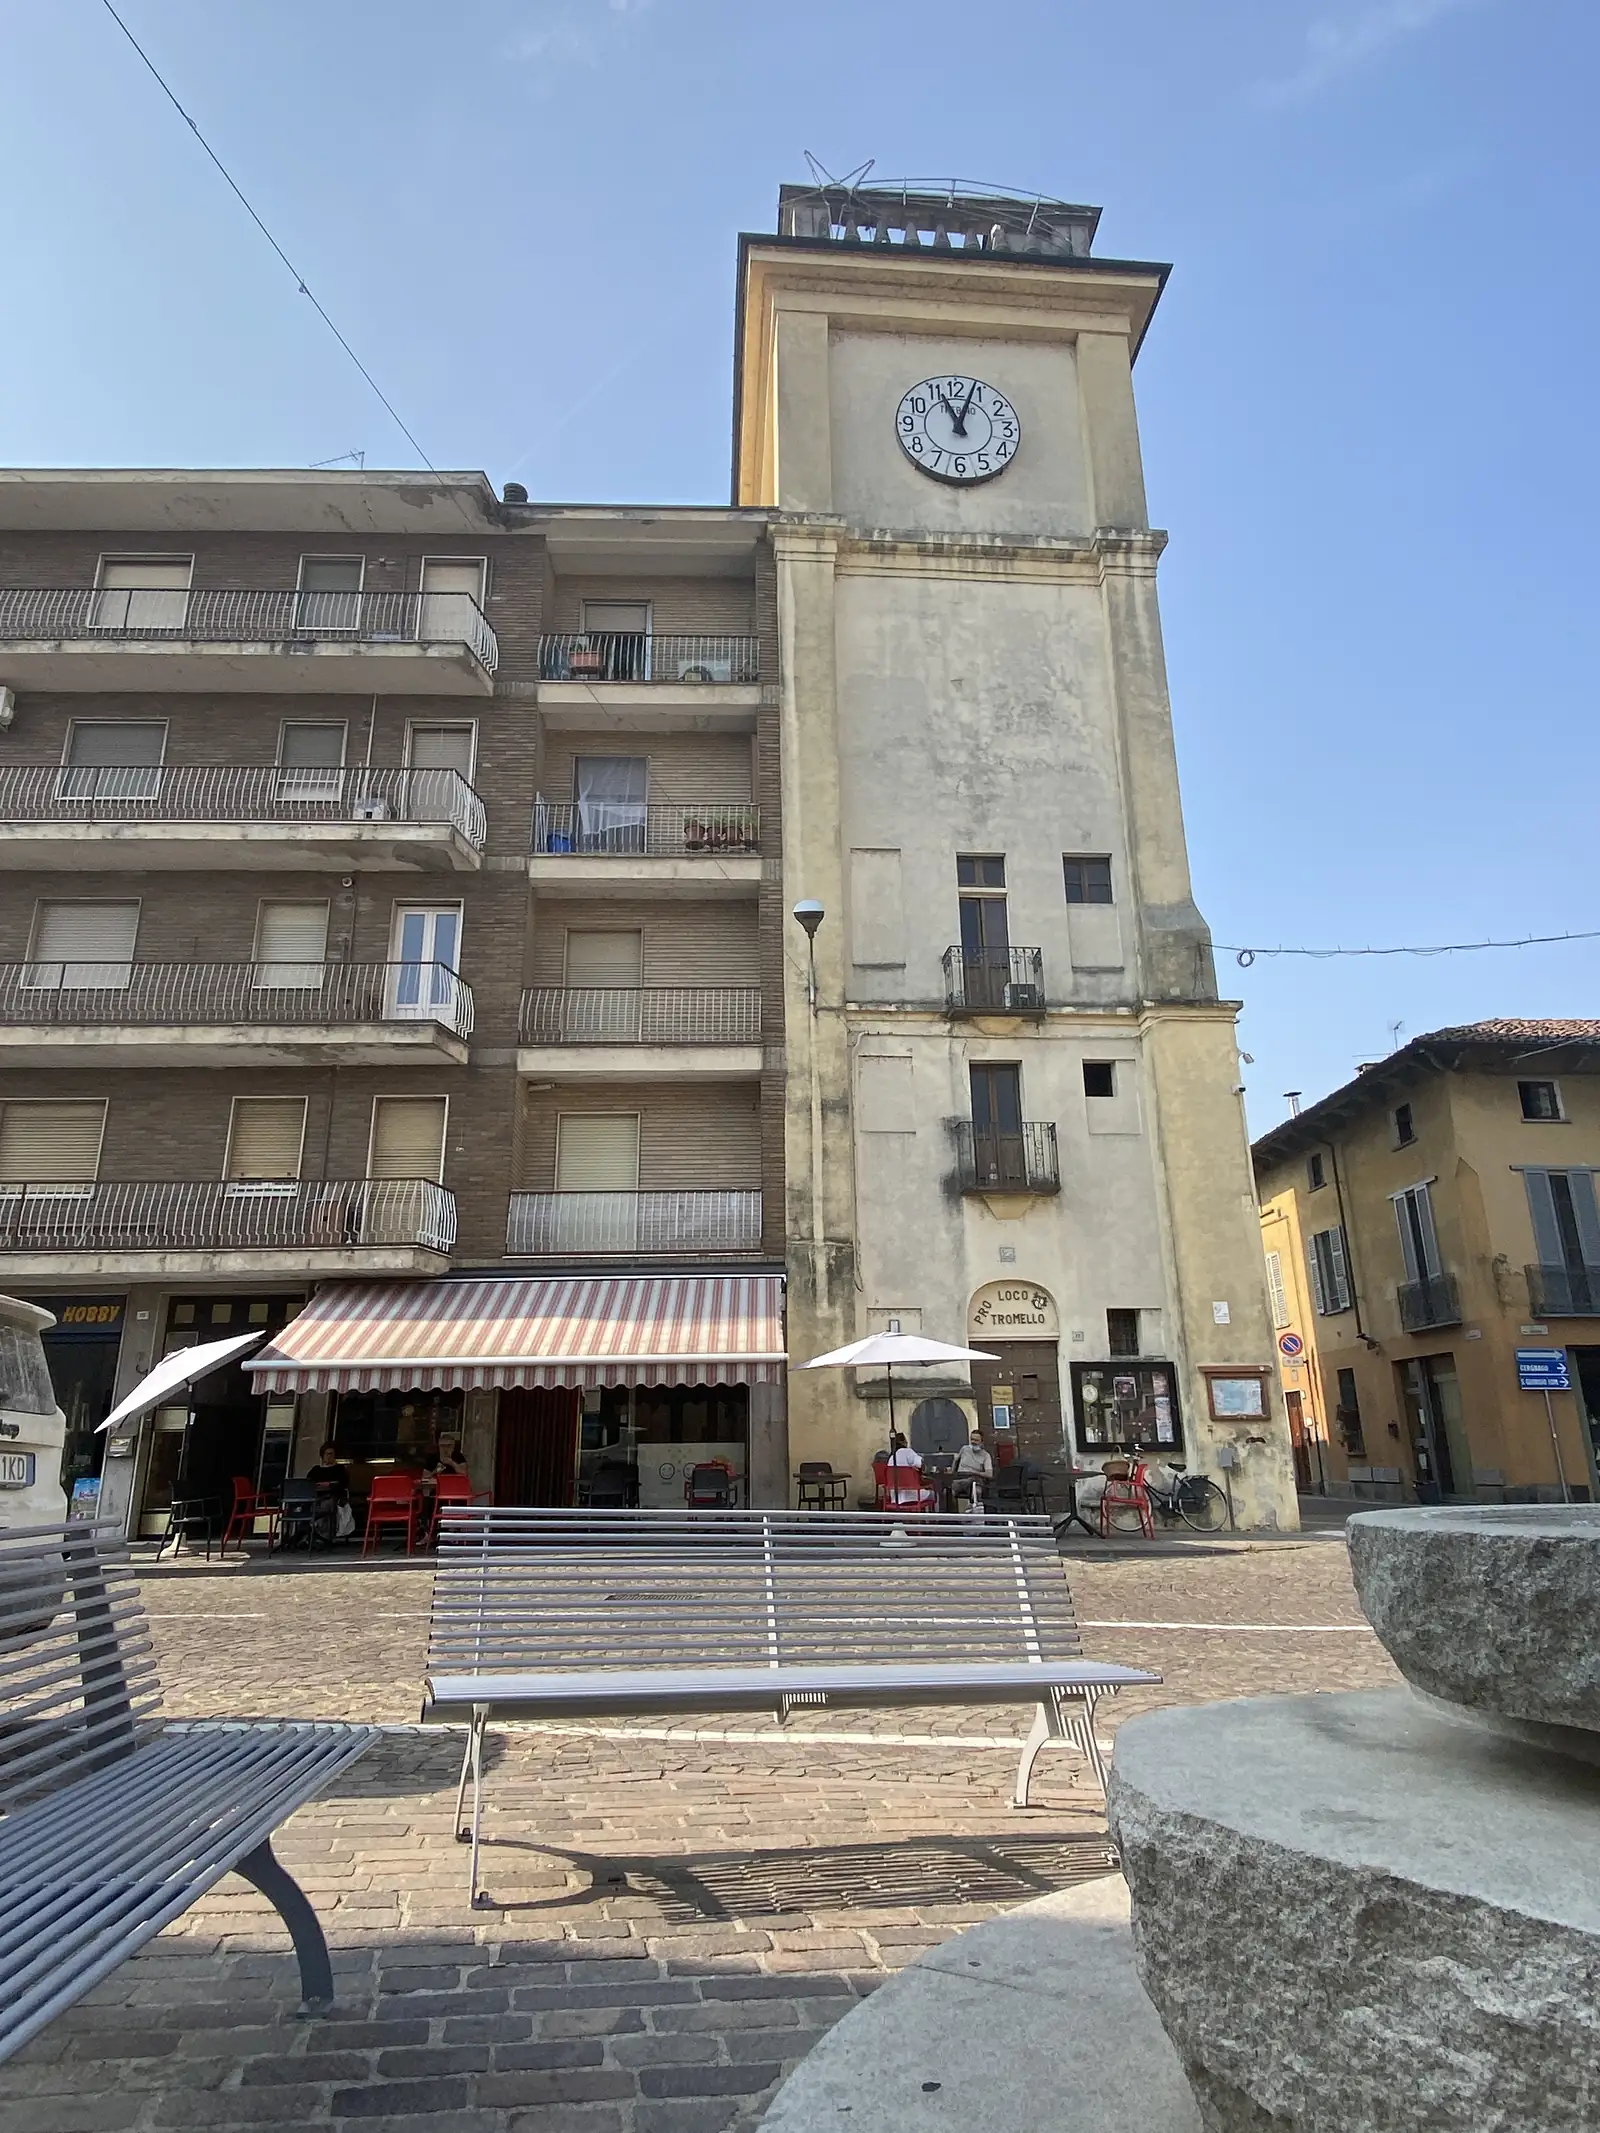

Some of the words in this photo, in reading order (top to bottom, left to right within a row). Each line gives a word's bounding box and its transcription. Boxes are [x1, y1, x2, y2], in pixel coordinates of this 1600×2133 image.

[928, 384, 942, 400] 11
[947, 381, 966, 398] 12
[976, 386, 982, 403] 1
[910, 397, 926, 414] 10
[992, 400, 1005, 417] 2
[902, 416, 914, 433] 9
[1002, 421, 1014, 438] 3
[911, 436, 923, 453] 8
[996, 441, 1008, 459] 4
[931, 450, 943, 468] 7
[954, 456, 966, 474] 6
[978, 453, 990, 471] 5
[63, 1305, 120, 1322] HOBBY
[973, 1300, 992, 1325] PRO
[998, 1290, 1028, 1301] LOCO
[991, 1313, 1045, 1325] TROMELLO
[2, 1456, 25, 1480] 1KD
